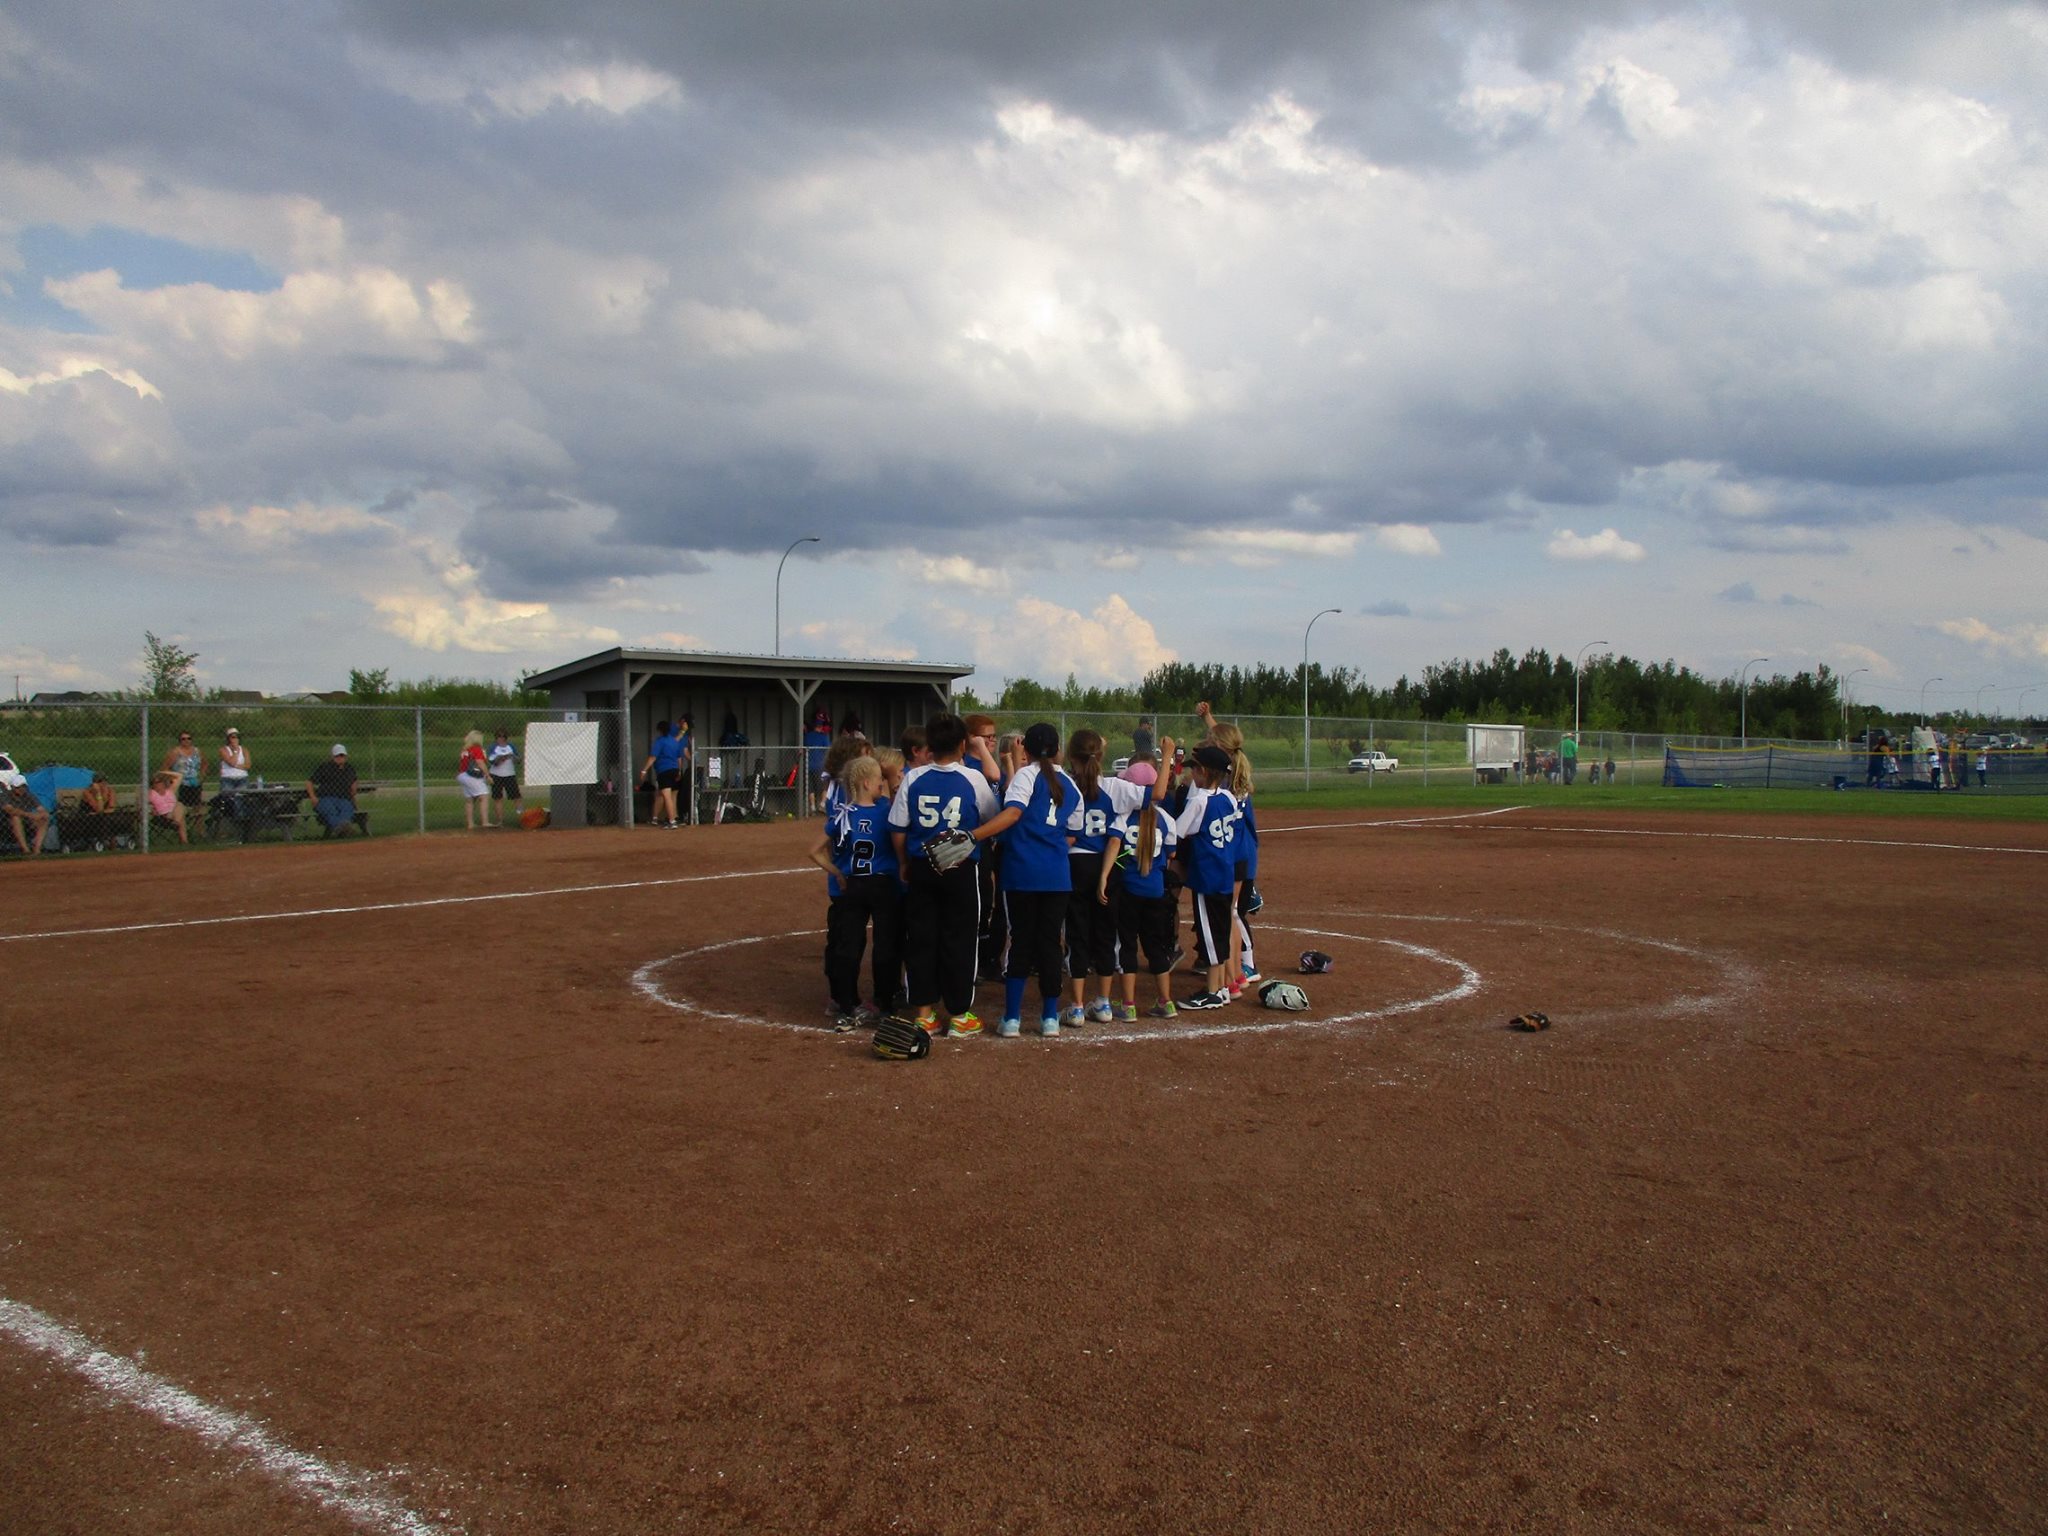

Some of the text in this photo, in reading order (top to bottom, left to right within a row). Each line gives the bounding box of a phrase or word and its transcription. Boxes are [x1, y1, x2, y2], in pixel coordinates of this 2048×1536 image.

[858, 819, 873, 834] R
[918, 794, 962, 828] 54
[1046, 798, 1058, 826] 1
[1085, 808, 1107, 837] 8
[1208, 811, 1243, 848] 95
[851, 839, 876, 876] 2
